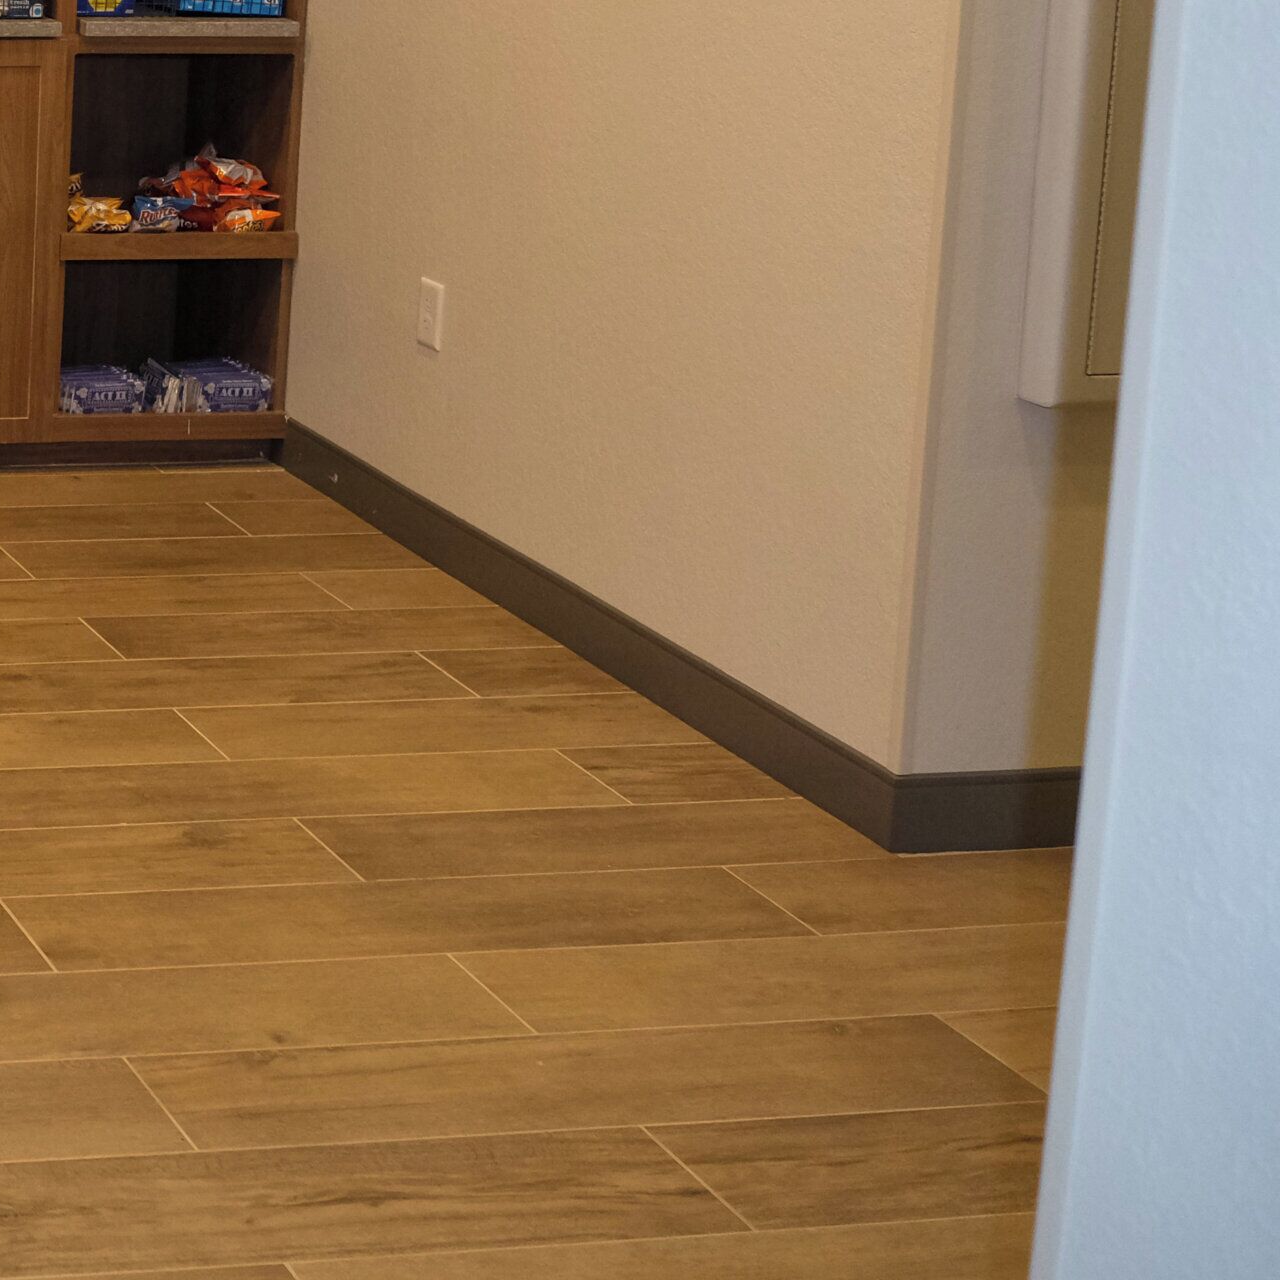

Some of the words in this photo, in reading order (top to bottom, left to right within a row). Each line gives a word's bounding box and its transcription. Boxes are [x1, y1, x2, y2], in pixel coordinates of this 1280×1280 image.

[95, 391, 114, 401] ACT
[115, 390, 128, 400] II
[221, 387, 240, 397] ACT
[243, 387, 253, 397] II
